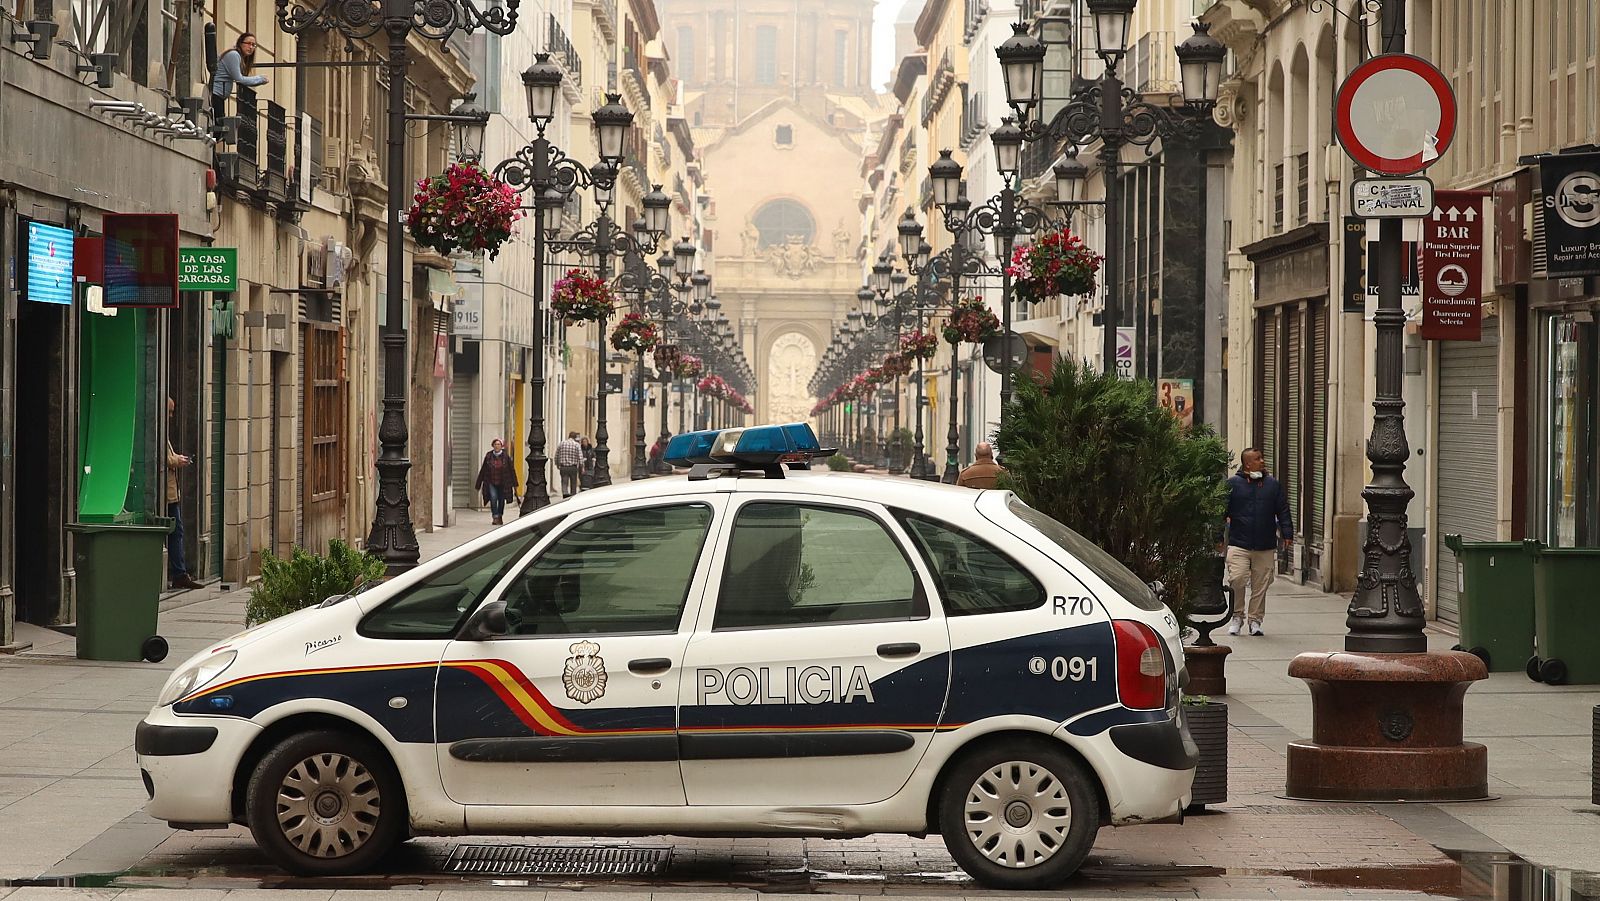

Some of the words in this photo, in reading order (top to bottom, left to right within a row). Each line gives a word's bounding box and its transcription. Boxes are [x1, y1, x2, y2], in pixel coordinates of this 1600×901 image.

[1437, 226, 1469, 239] BAR
[1425, 242, 1448, 250] Planta
[1449, 243, 1480, 252] Superior
[1560, 244, 1588, 253] Luxury
[182, 255, 196, 263] LA
[199, 255, 226, 264] CASA
[1452, 251, 1471, 259] Floor
[1553, 253, 1574, 263] Repair
[1575, 252, 1587, 260] and
[184, 265, 199, 273] DE
[203, 265, 223, 274] LAS
[178, 275, 230, 283] CARCASAS
[1439, 317, 1464, 325] Selecta
[1161, 382, 1172, 408] 3
[1052, 595, 1094, 616] R70
[1051, 656, 1098, 682] 091
[696, 665, 875, 706] POLICIA
